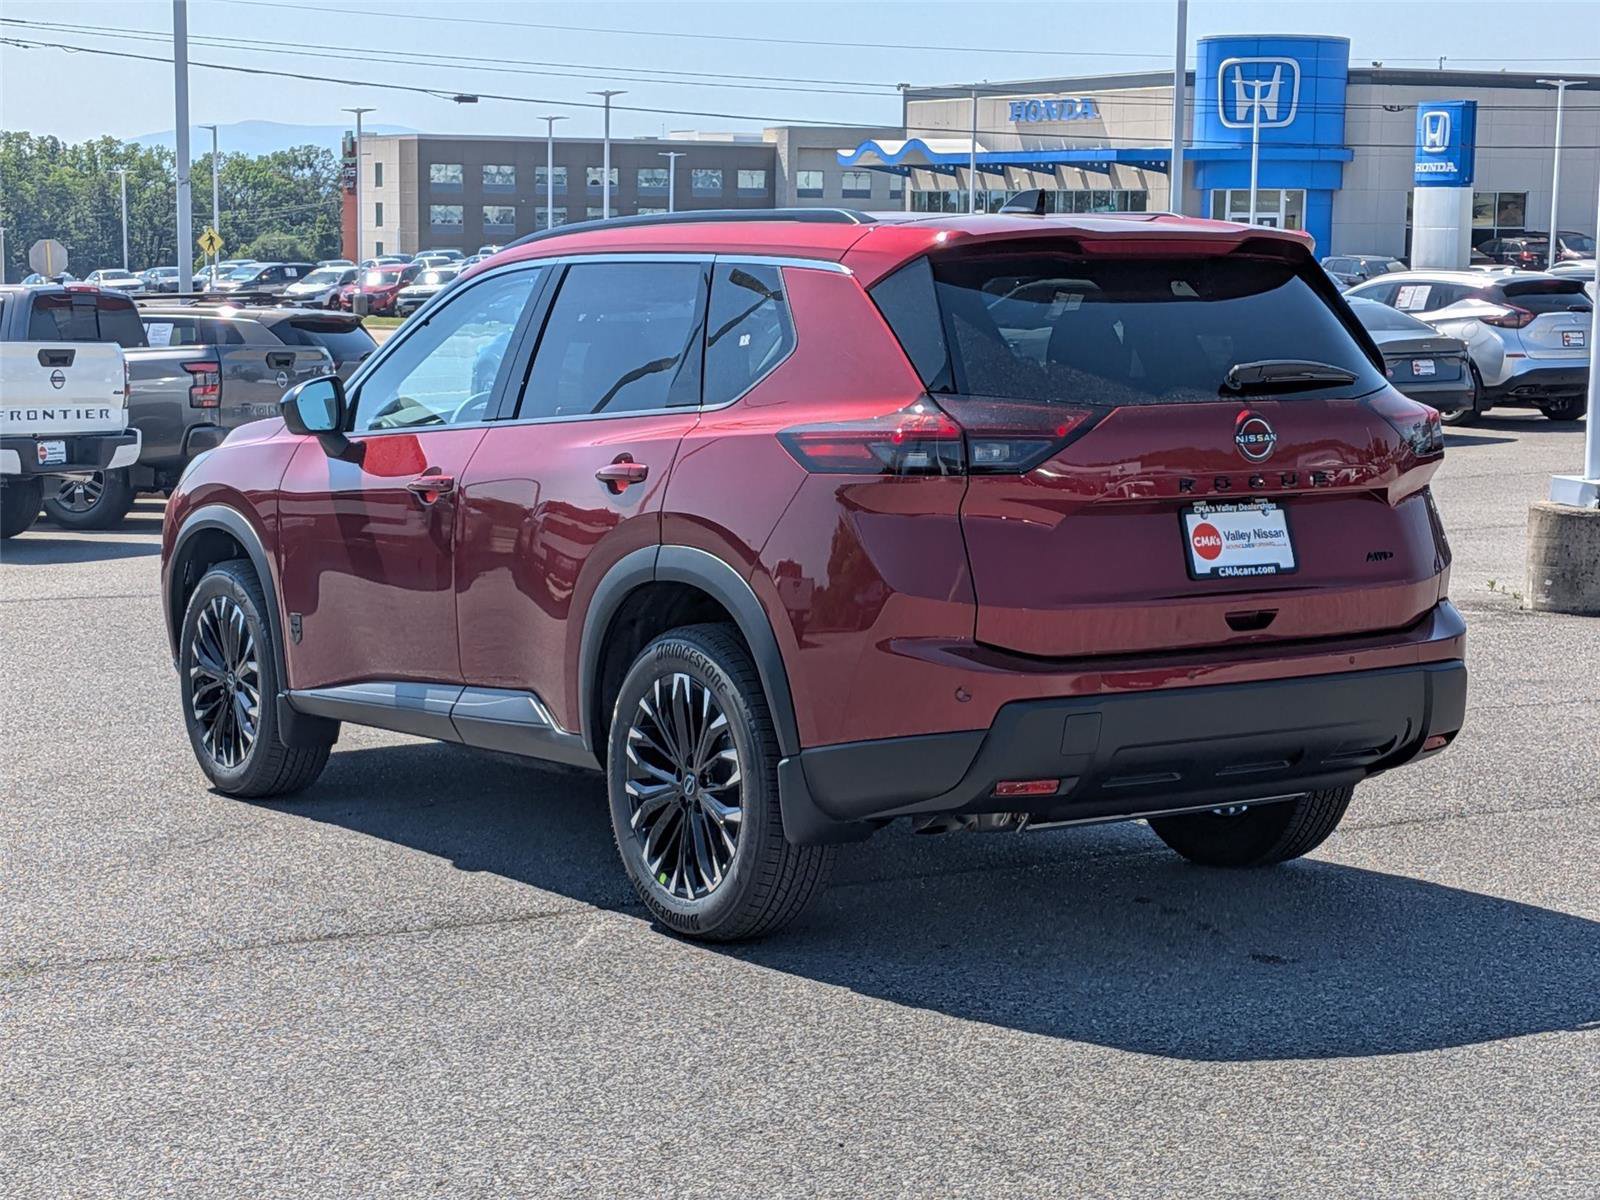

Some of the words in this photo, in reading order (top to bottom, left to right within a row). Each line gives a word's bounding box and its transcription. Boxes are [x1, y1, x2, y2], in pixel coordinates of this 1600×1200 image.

[1008, 98, 1101, 122] HONDA
[1415, 162, 1458, 172] HONDA
[1235, 433, 1277, 444] NISSAN
[1179, 470, 1331, 494] ROGUE
[1193, 505, 1216, 513] CMA's
[1216, 504, 1238, 512] Valley
[1238, 503, 1277, 511] Dealerships
[1194, 535, 1220, 547] CMA's
[1223, 530, 1251, 542] Valley
[1253, 528, 1285, 540] Nissan
[1219, 566, 1276, 577] CMAcars.com
[655, 642, 728, 694] BRIDGESTONE
